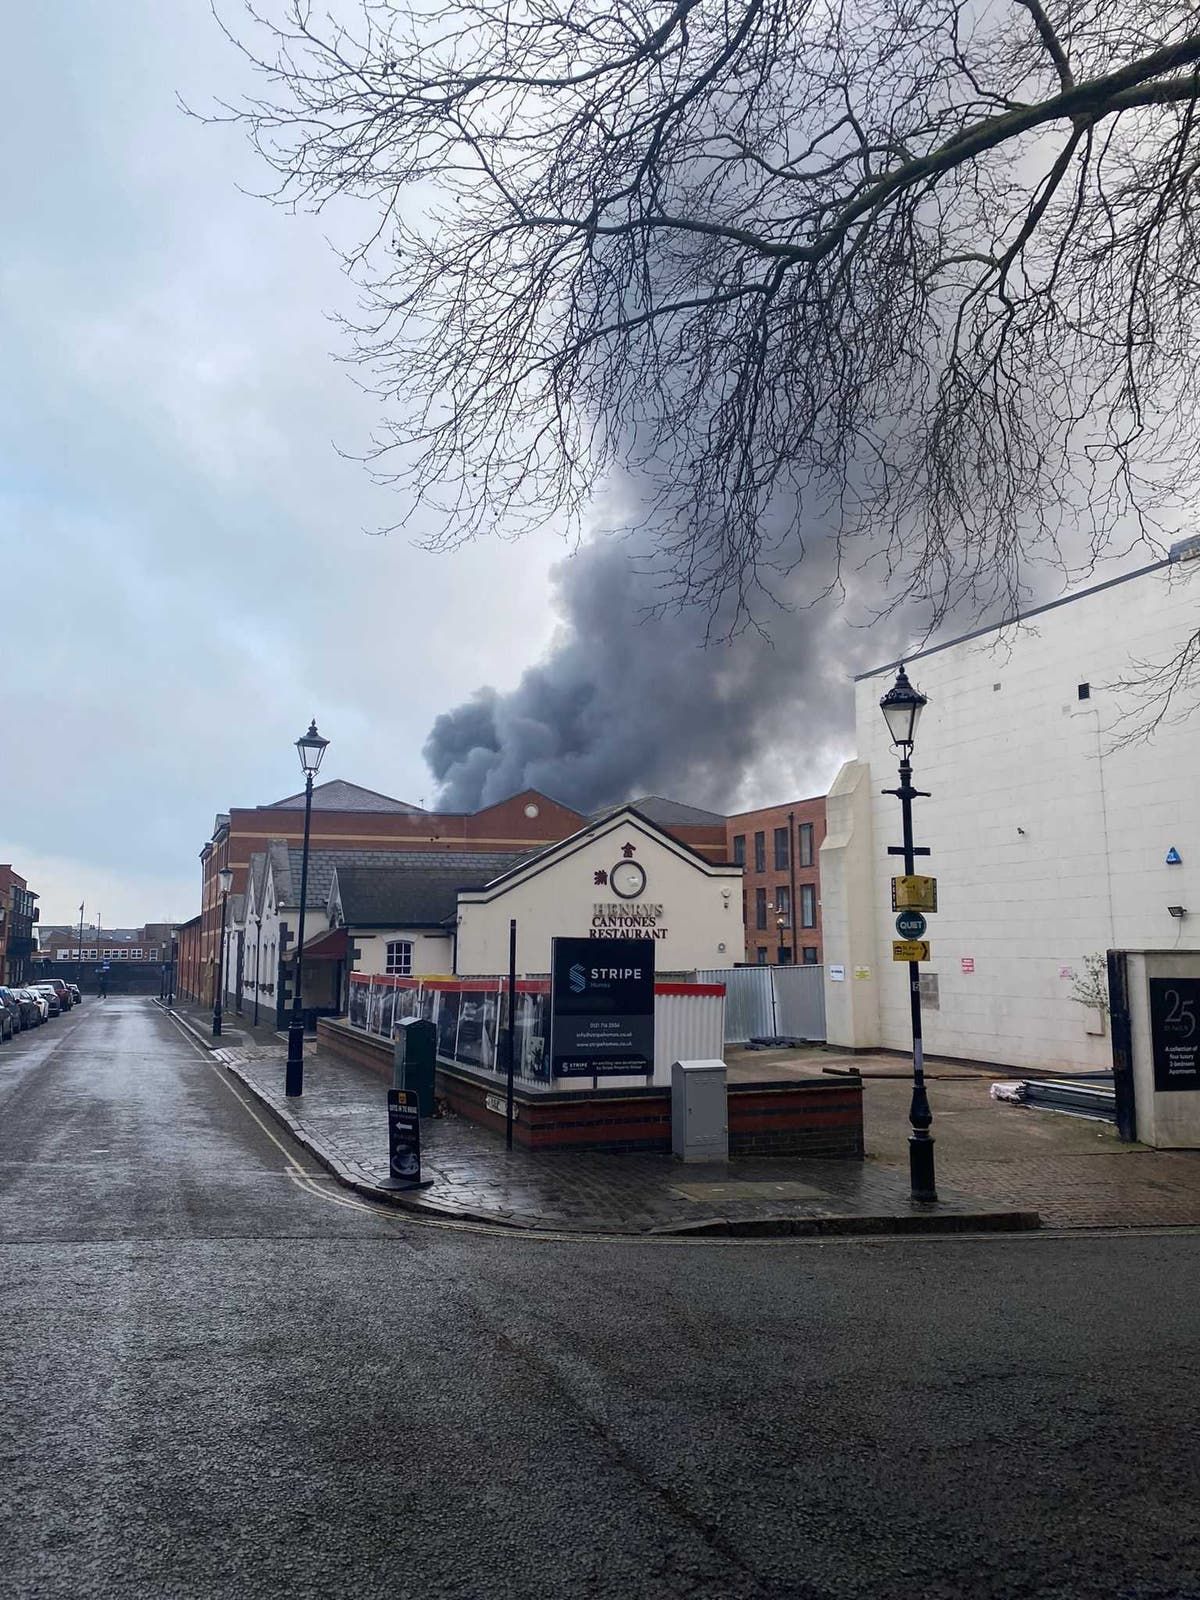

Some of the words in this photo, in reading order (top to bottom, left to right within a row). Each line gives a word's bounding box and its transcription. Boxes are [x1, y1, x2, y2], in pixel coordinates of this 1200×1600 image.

[592, 917, 656, 928] CANTONES
[589, 928, 668, 939] RESTAURANT
[591, 968, 642, 979] STRIPE
[1165, 989, 1196, 1038] 25
